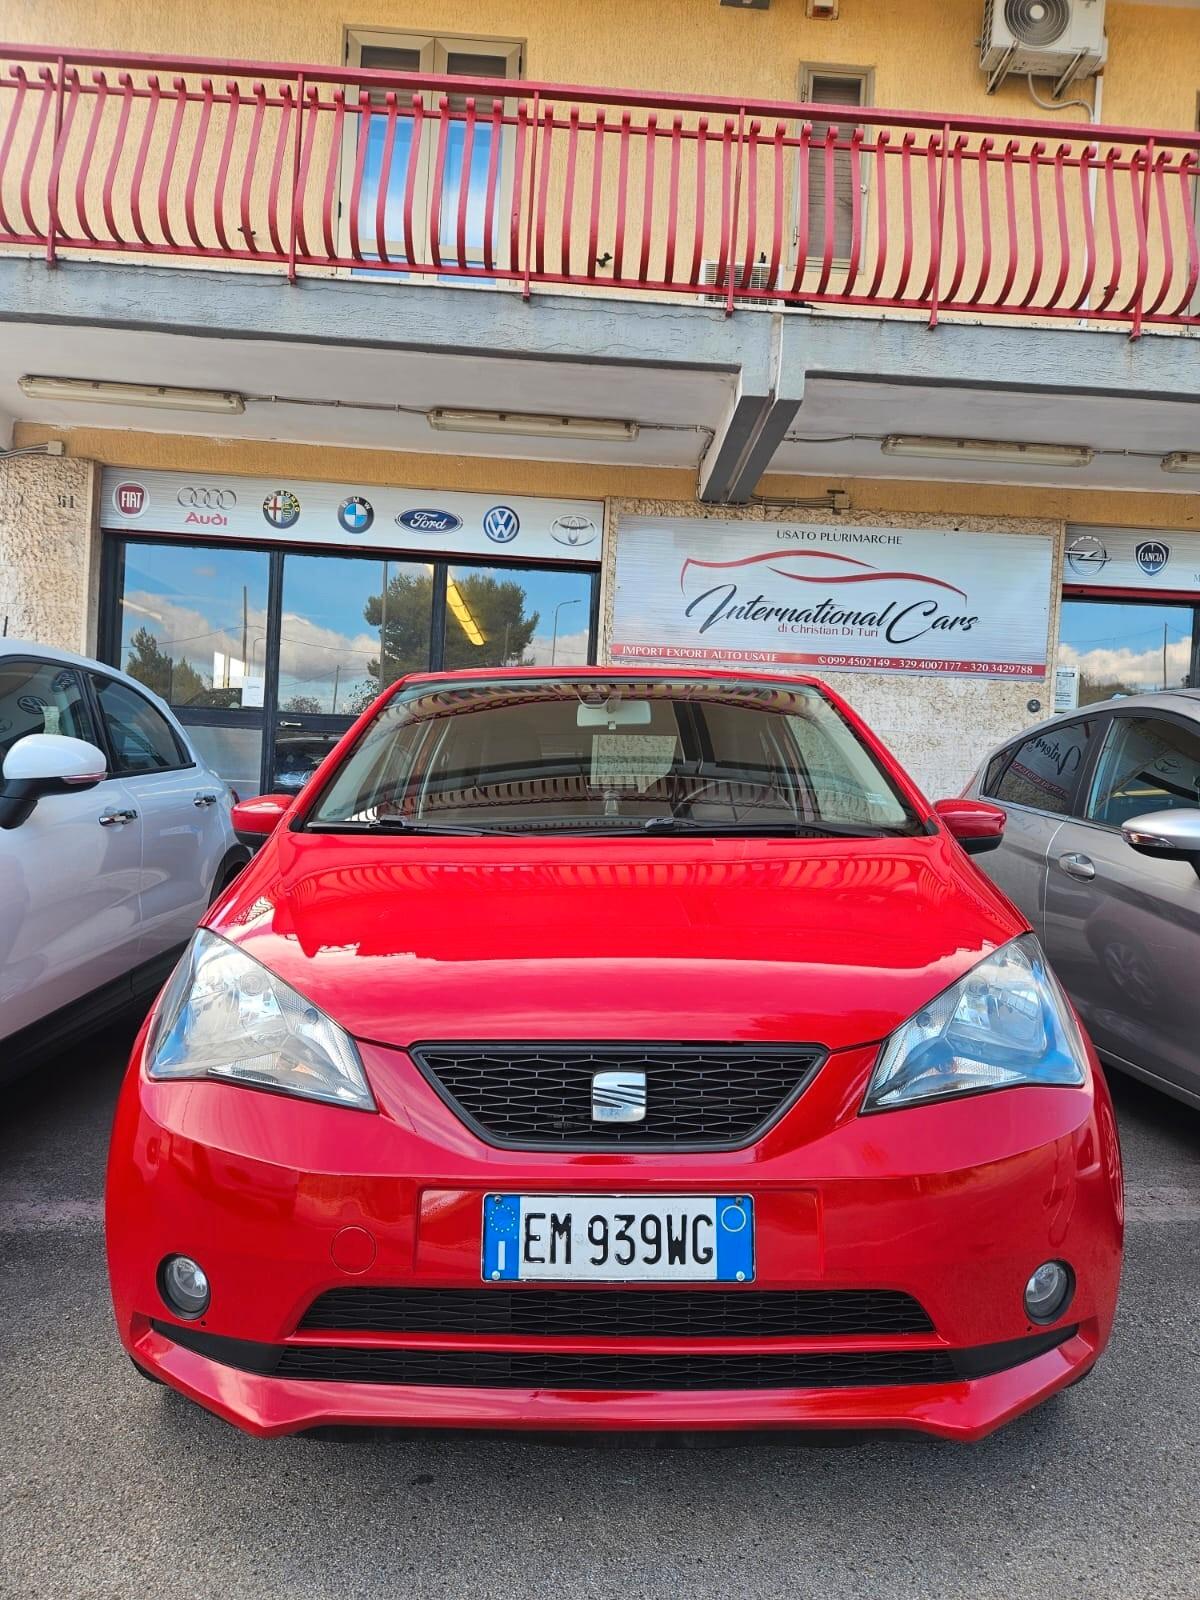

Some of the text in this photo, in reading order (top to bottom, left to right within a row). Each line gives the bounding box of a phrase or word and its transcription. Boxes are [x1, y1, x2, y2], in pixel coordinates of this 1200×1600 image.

[121, 491, 143, 509] FIAT
[185, 511, 228, 526] Audi
[410, 511, 448, 531] Ford
[776, 529, 903, 545] USATO PLURIMARCHE
[1141, 552, 1163, 562] LANCIA
[685, 583, 980, 644] International Cars
[777, 624, 879, 637] di Christian Di Turi
[622, 645, 663, 656] IMPORT
[666, 648, 709, 659] EXPORT
[711, 650, 742, 660] AUTO
[744, 652, 778, 662] USATE
[827, 656, 890, 668] 099.4502149
[898, 660, 961, 671] 329.4007177
[970, 663, 1033, 674] 320.3429788
[523, 1212, 714, 1266] EM 939WG
